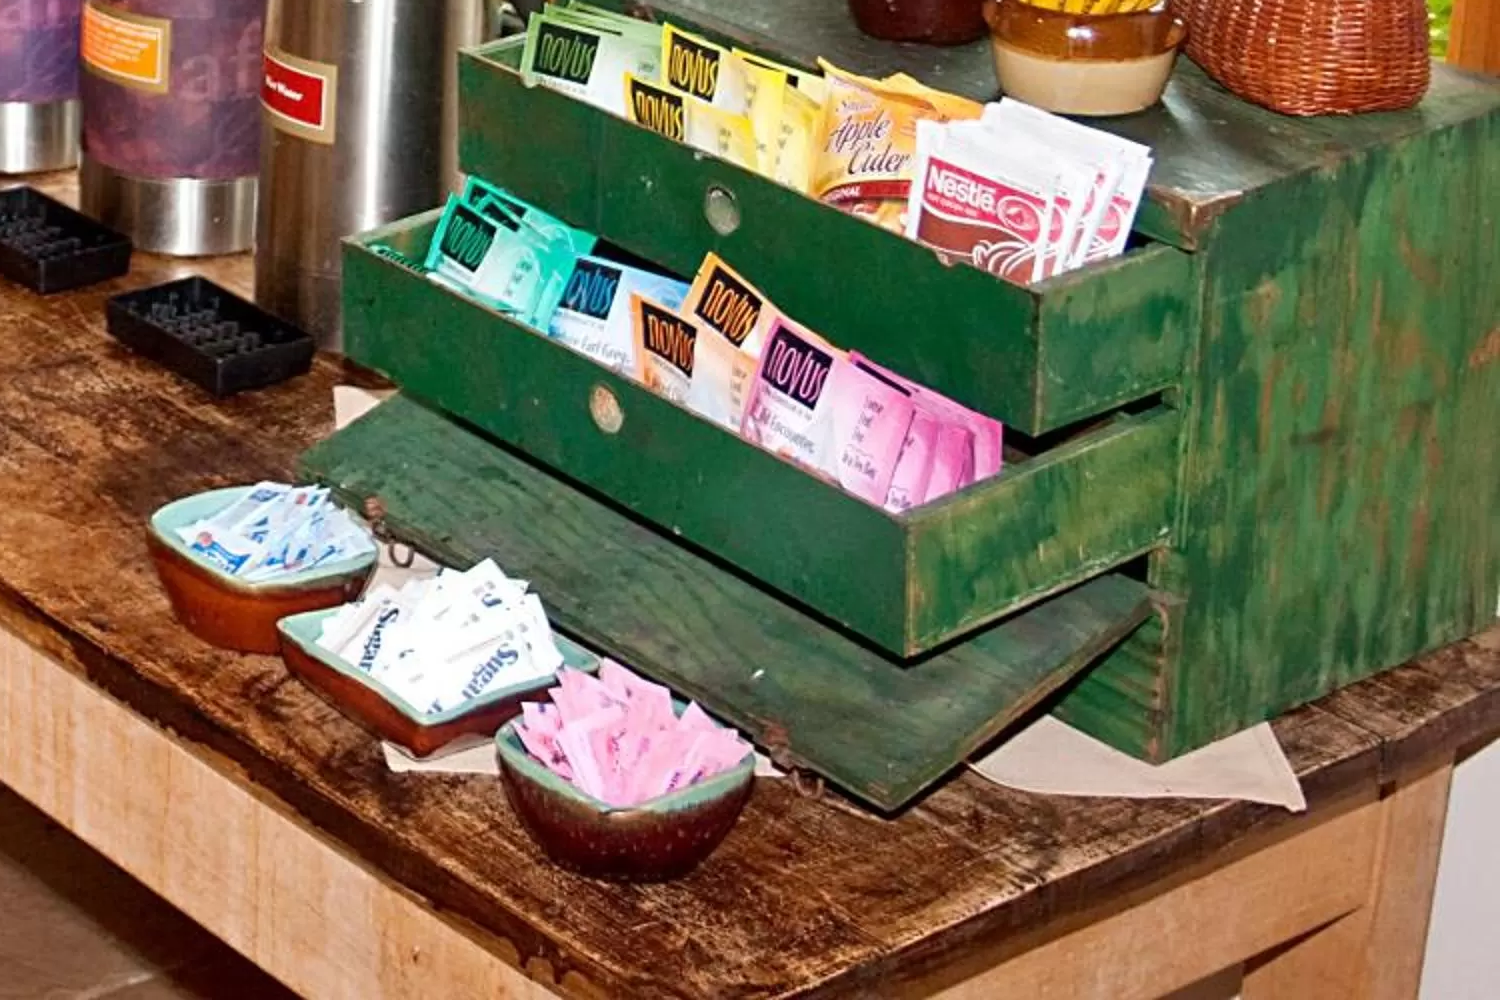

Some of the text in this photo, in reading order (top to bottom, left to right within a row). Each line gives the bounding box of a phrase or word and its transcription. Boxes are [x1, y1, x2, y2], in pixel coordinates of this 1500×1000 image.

[824, 109, 890, 153] Apple
[847, 141, 911, 175] Cider
[928, 166, 997, 214] Nestlé
[359, 607, 400, 673] Sugar
[461, 642, 520, 701] Sugar
